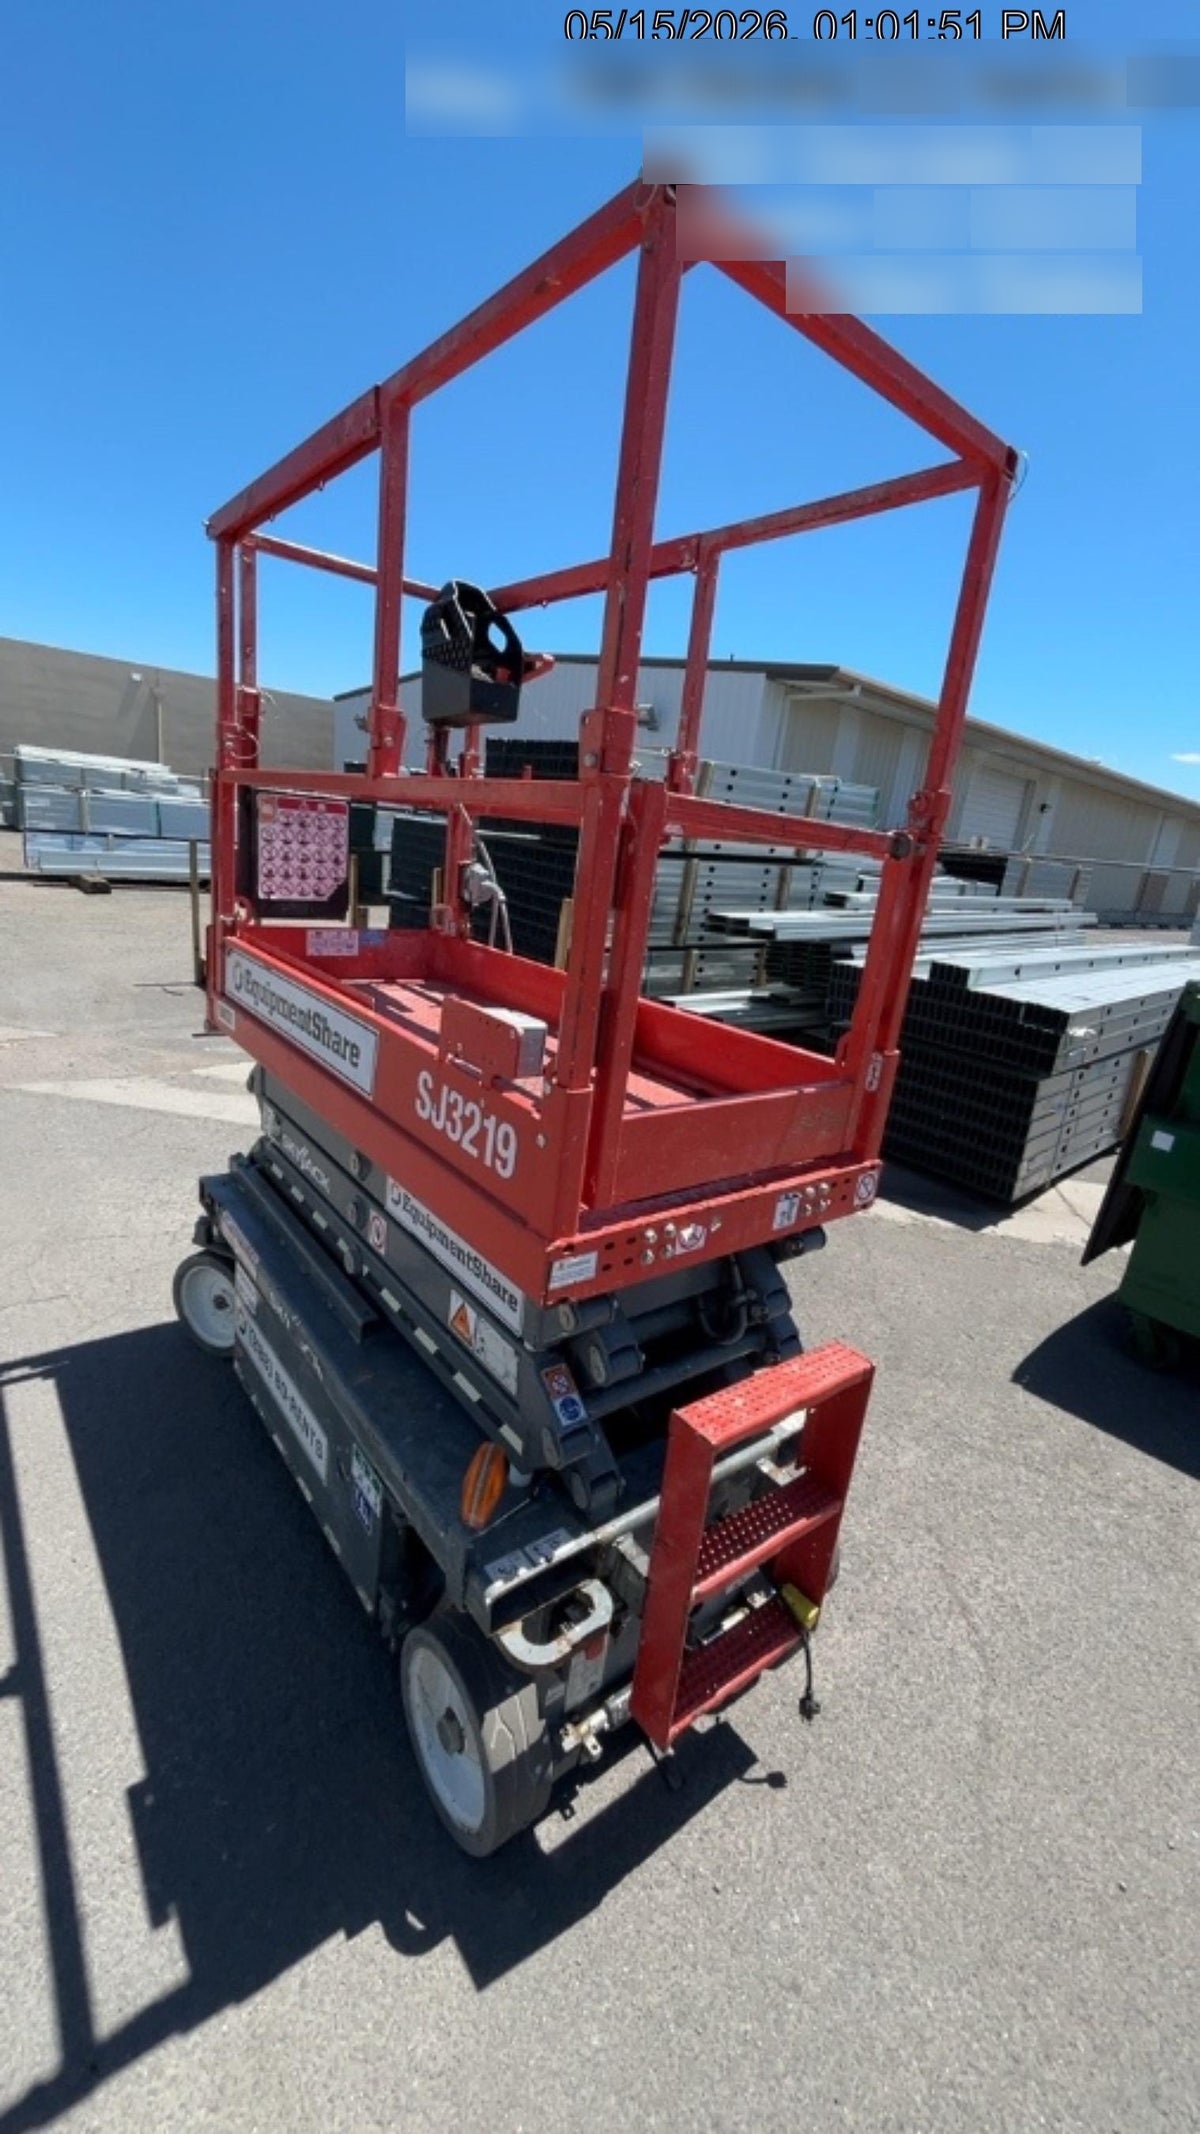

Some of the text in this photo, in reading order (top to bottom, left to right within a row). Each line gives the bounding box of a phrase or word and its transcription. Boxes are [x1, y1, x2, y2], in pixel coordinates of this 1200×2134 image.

[244, 970, 360, 1068] EquipmentShare
[415, 1070, 517, 1178] SJ3219
[403, 1193, 518, 1312] EquipmentShare
